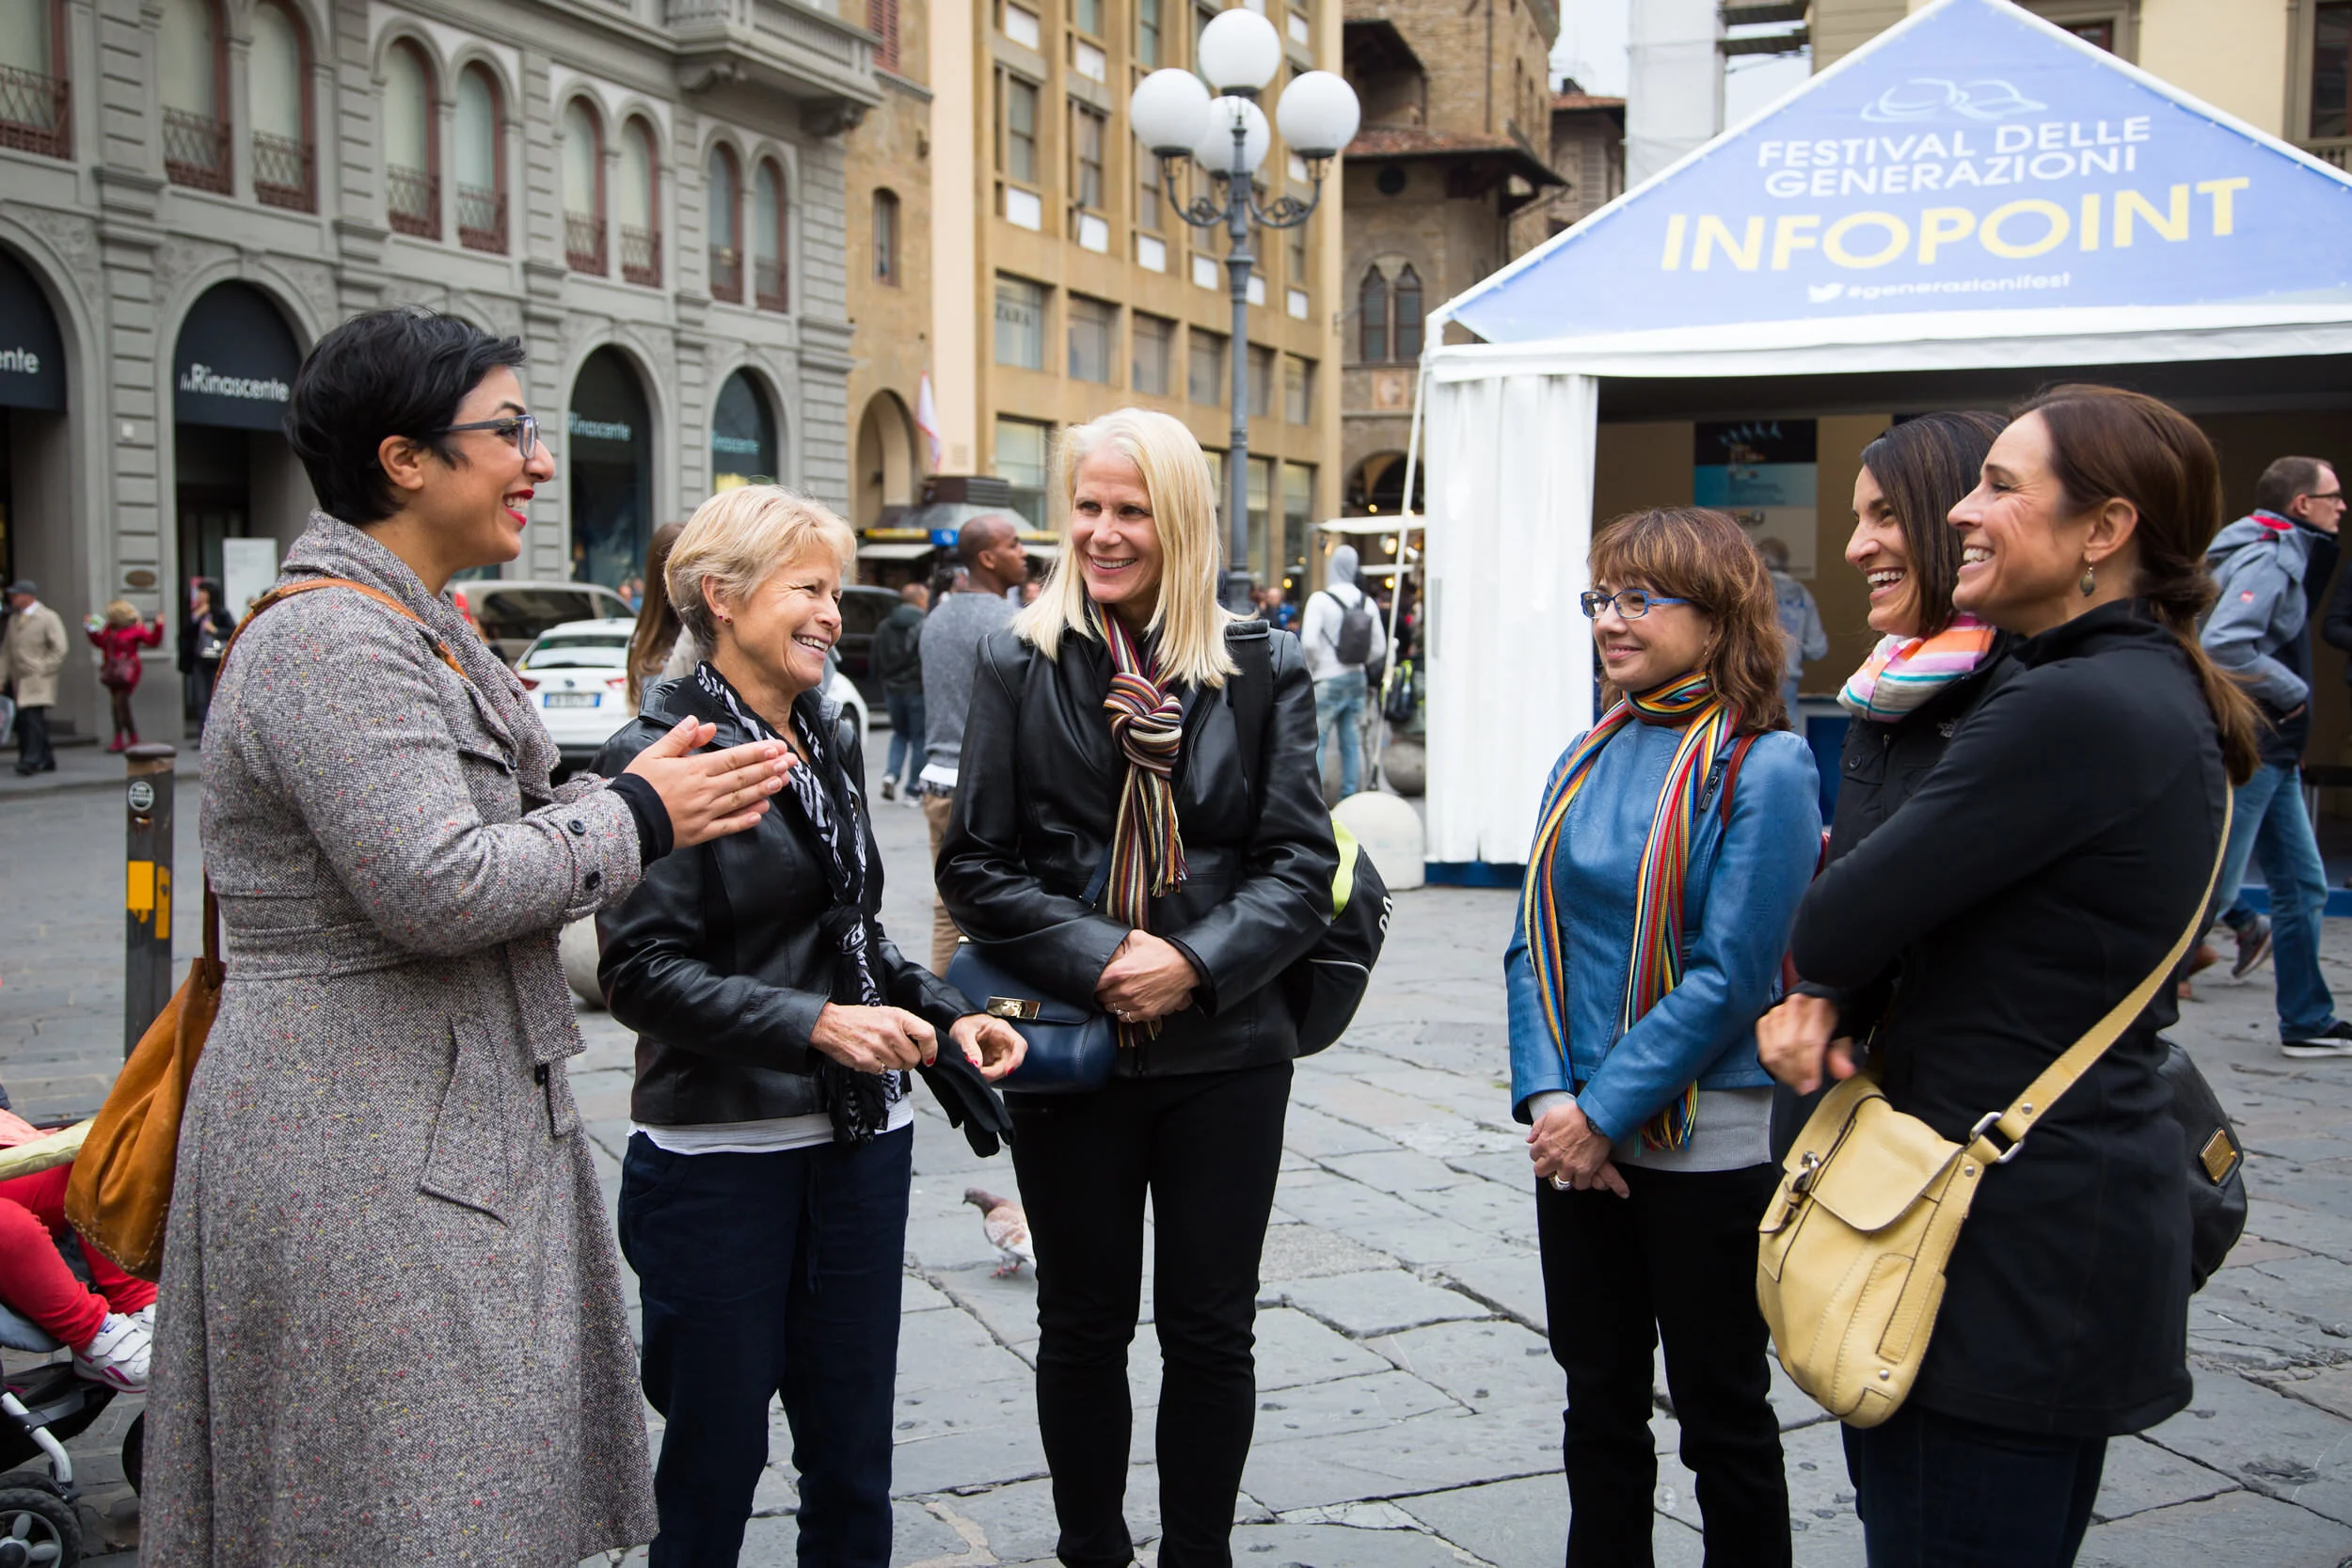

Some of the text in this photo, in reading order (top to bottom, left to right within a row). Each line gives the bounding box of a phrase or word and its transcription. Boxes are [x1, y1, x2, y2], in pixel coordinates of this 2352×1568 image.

[1757, 115, 2151, 168] FESTIVAL DELLE
[1765, 144, 2136, 198] GENERAZIONI
[1661, 176, 2249, 271] INFOPOINT
